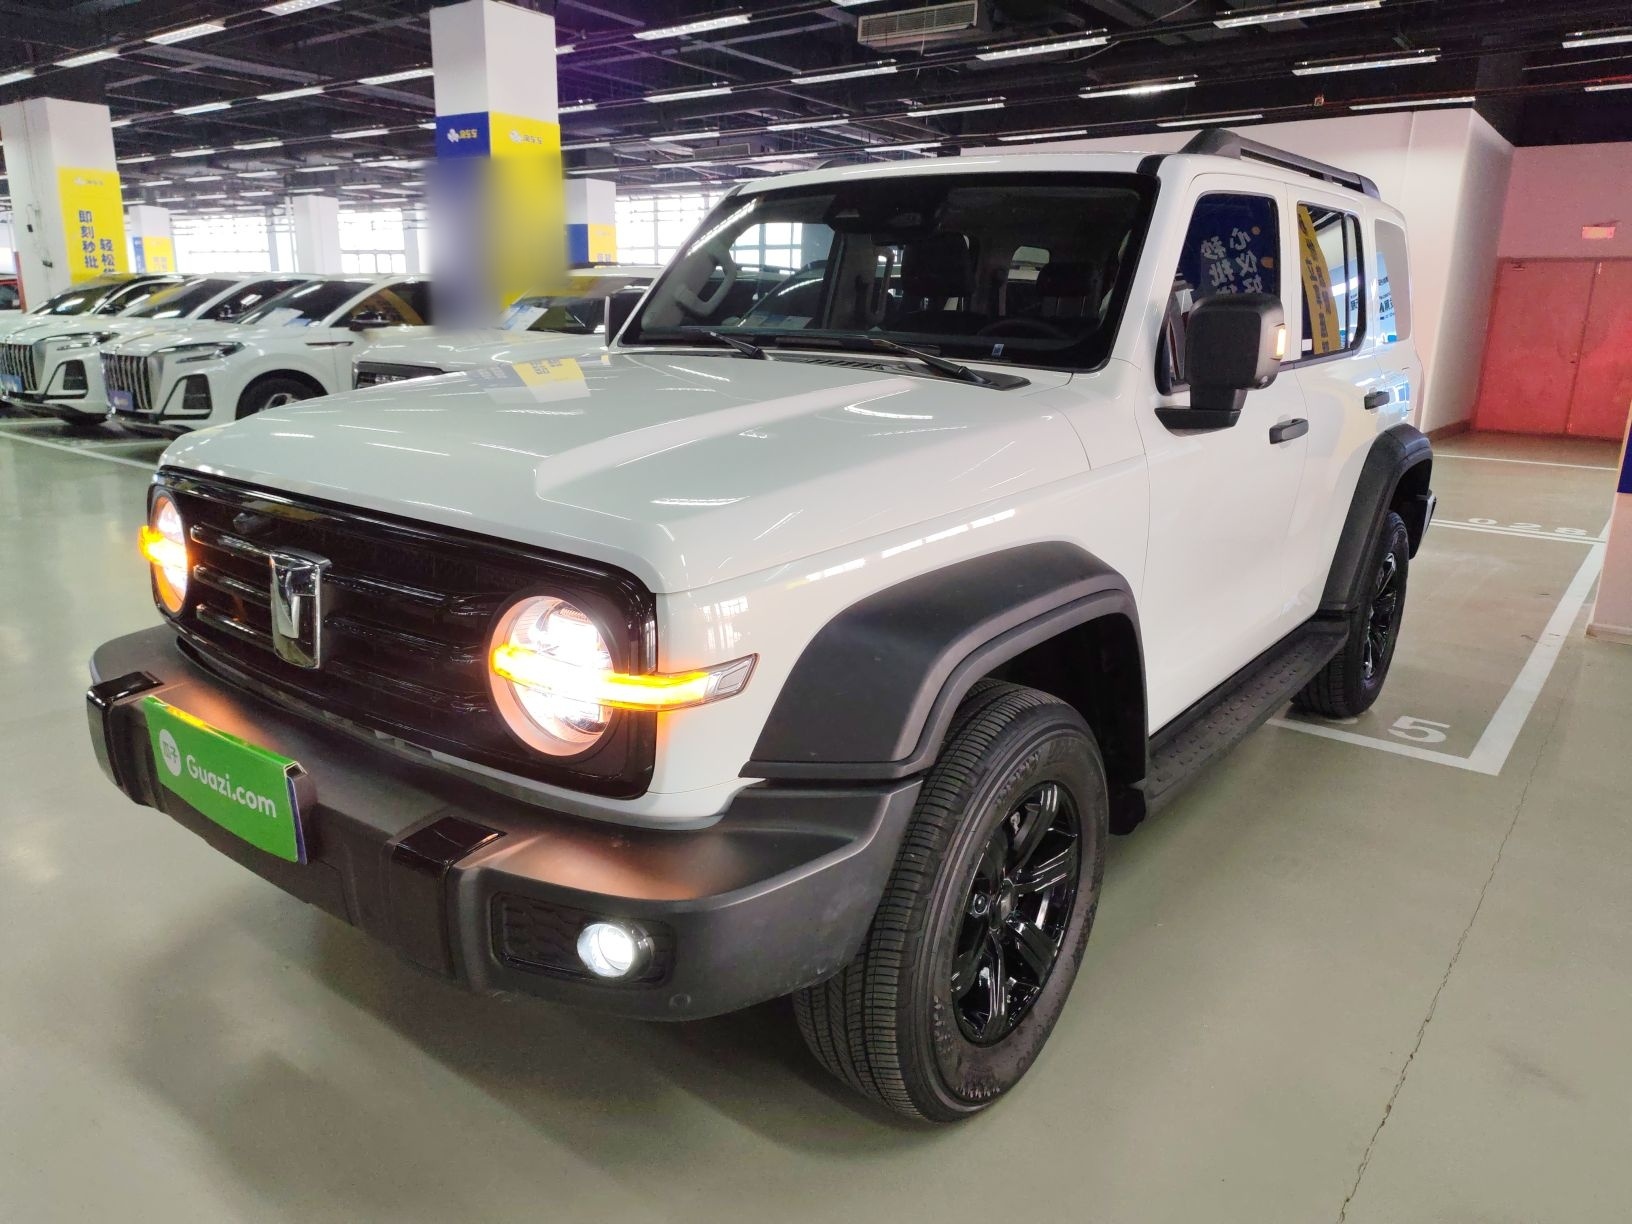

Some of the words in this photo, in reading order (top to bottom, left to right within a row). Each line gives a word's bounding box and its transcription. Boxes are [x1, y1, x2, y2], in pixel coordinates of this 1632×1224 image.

[79, 210, 98, 269] 即刻秒批
[186, 754, 277, 818] Guazi.com
